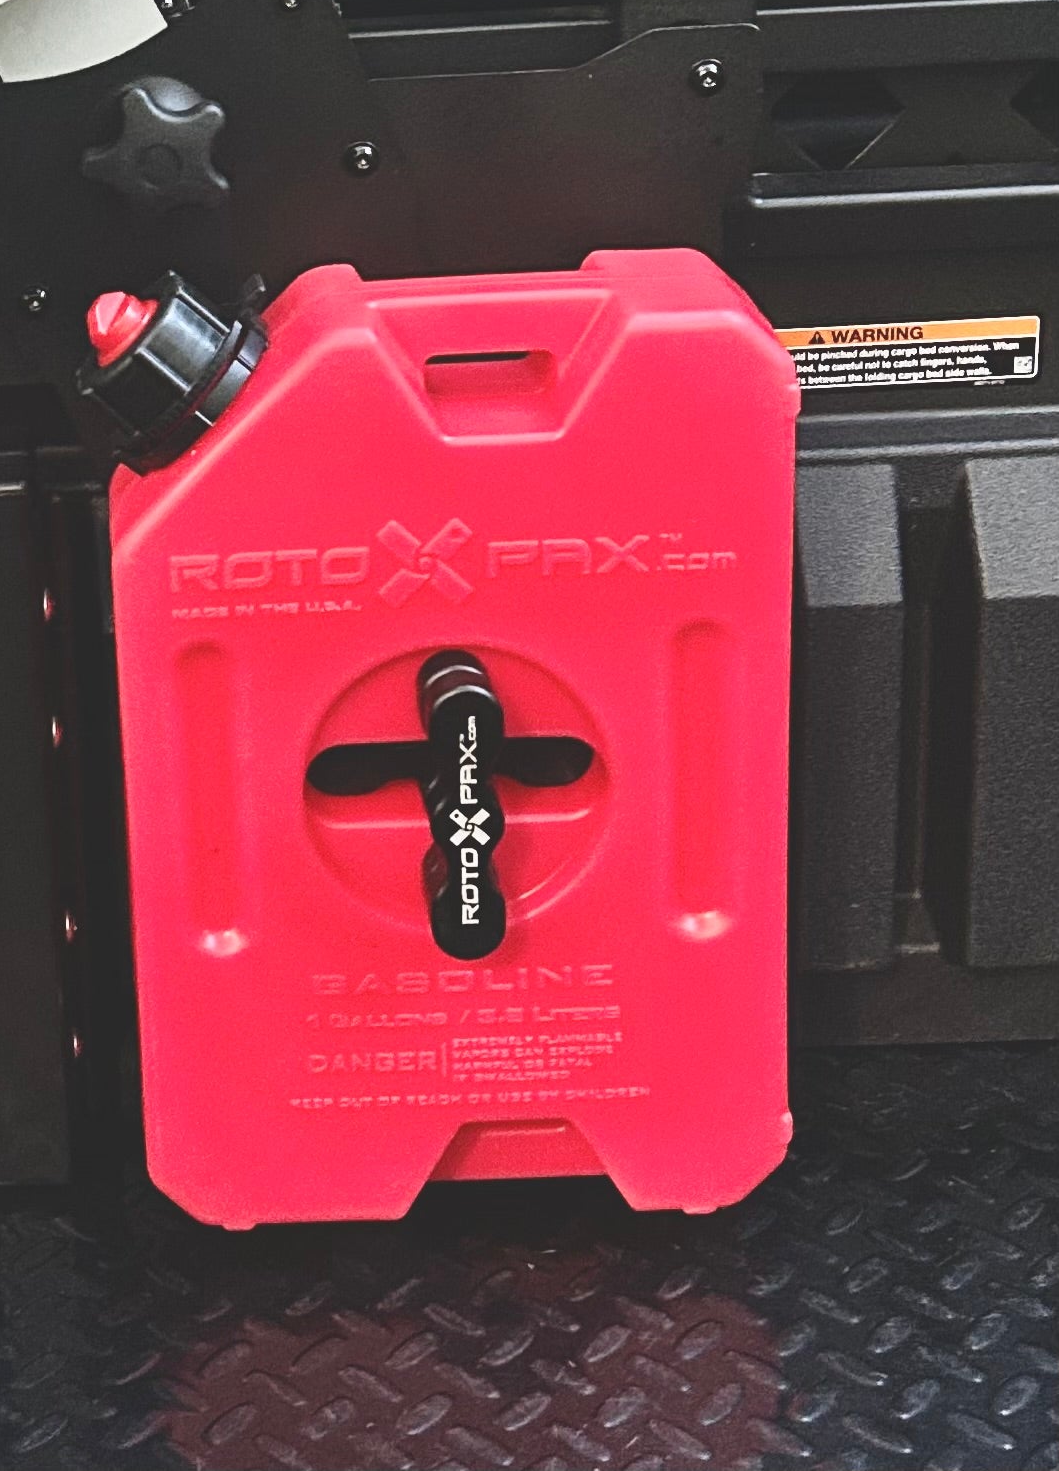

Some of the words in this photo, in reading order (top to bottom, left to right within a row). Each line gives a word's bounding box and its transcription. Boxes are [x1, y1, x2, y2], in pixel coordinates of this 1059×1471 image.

[831, 327, 924, 344] WARNING
[807, 351, 820, 361] be
[820, 349, 858, 362] pinched
[858, 348, 890, 359] during
[890, 346, 918, 358] cargo
[918, 345, 937, 355] bed
[937, 343, 992, 354] conversion.
[992, 341, 1020, 351] When
[817, 362, 831, 372] be
[831, 360, 864, 371] careful
[864, 360, 881, 369] not
[881, 359, 892, 369] to
[892, 358, 919, 369] catch
[919, 357, 955, 369] fingers,
[956, 354, 988, 365] hands,
[807, 374, 847, 385] between
[847, 372, 864, 382] the
[864, 372, 897, 383] folding
[897, 370, 925, 381] cargo
[925, 368, 944, 379] bed
[944, 367, 965, 378] side
[168, 546, 370, 592] ROTO
[488, 533, 651, 578] PAX
[171, 605, 230, 620] MADE
[234, 603, 256, 616] IN
[259, 602, 300, 615] THE
[459, 740, 479, 805] PAX
[461, 847, 480, 926] ROTO
[312, 964, 614, 995] GASOLINE
[532, 1005, 621, 1022] LITERS
[308, 1049, 437, 1074] DANGER
